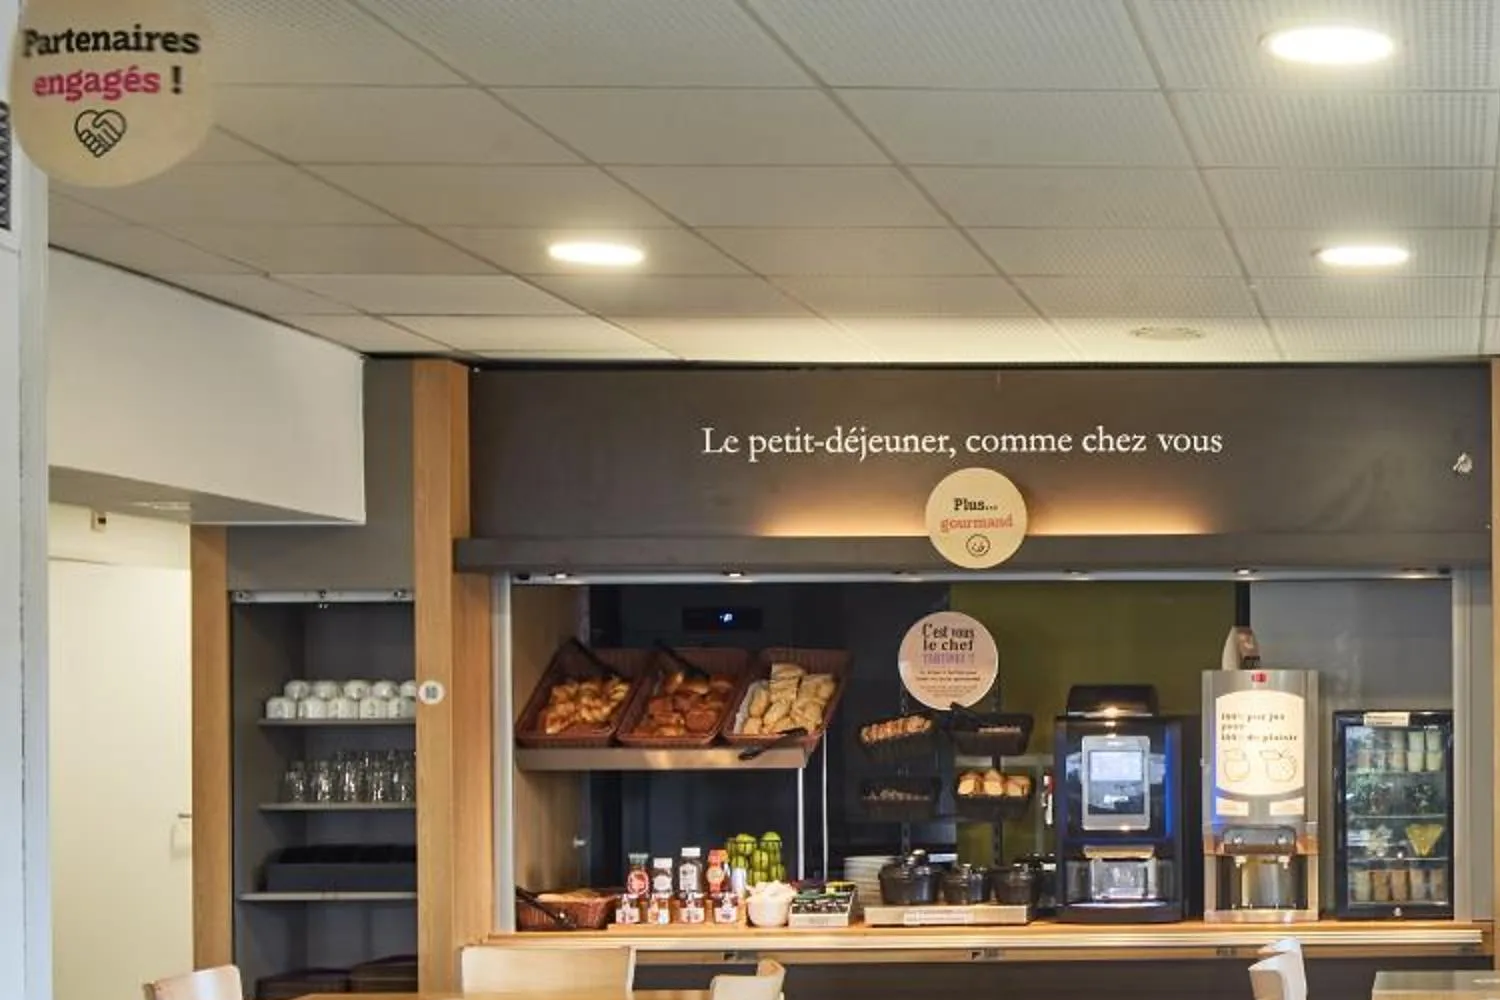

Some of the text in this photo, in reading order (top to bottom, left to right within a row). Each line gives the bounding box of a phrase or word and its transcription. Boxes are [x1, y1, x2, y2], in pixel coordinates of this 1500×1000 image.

[22, 23, 201, 57] Partenaires
[33, 65, 182, 102] engagés !
[701, 425, 1223, 463] Le petit-déjeuner, comme chez vous
[940, 513, 1014, 533] gourmand
[922, 623, 948, 639] C'est
[923, 638, 974, 651] le chef
